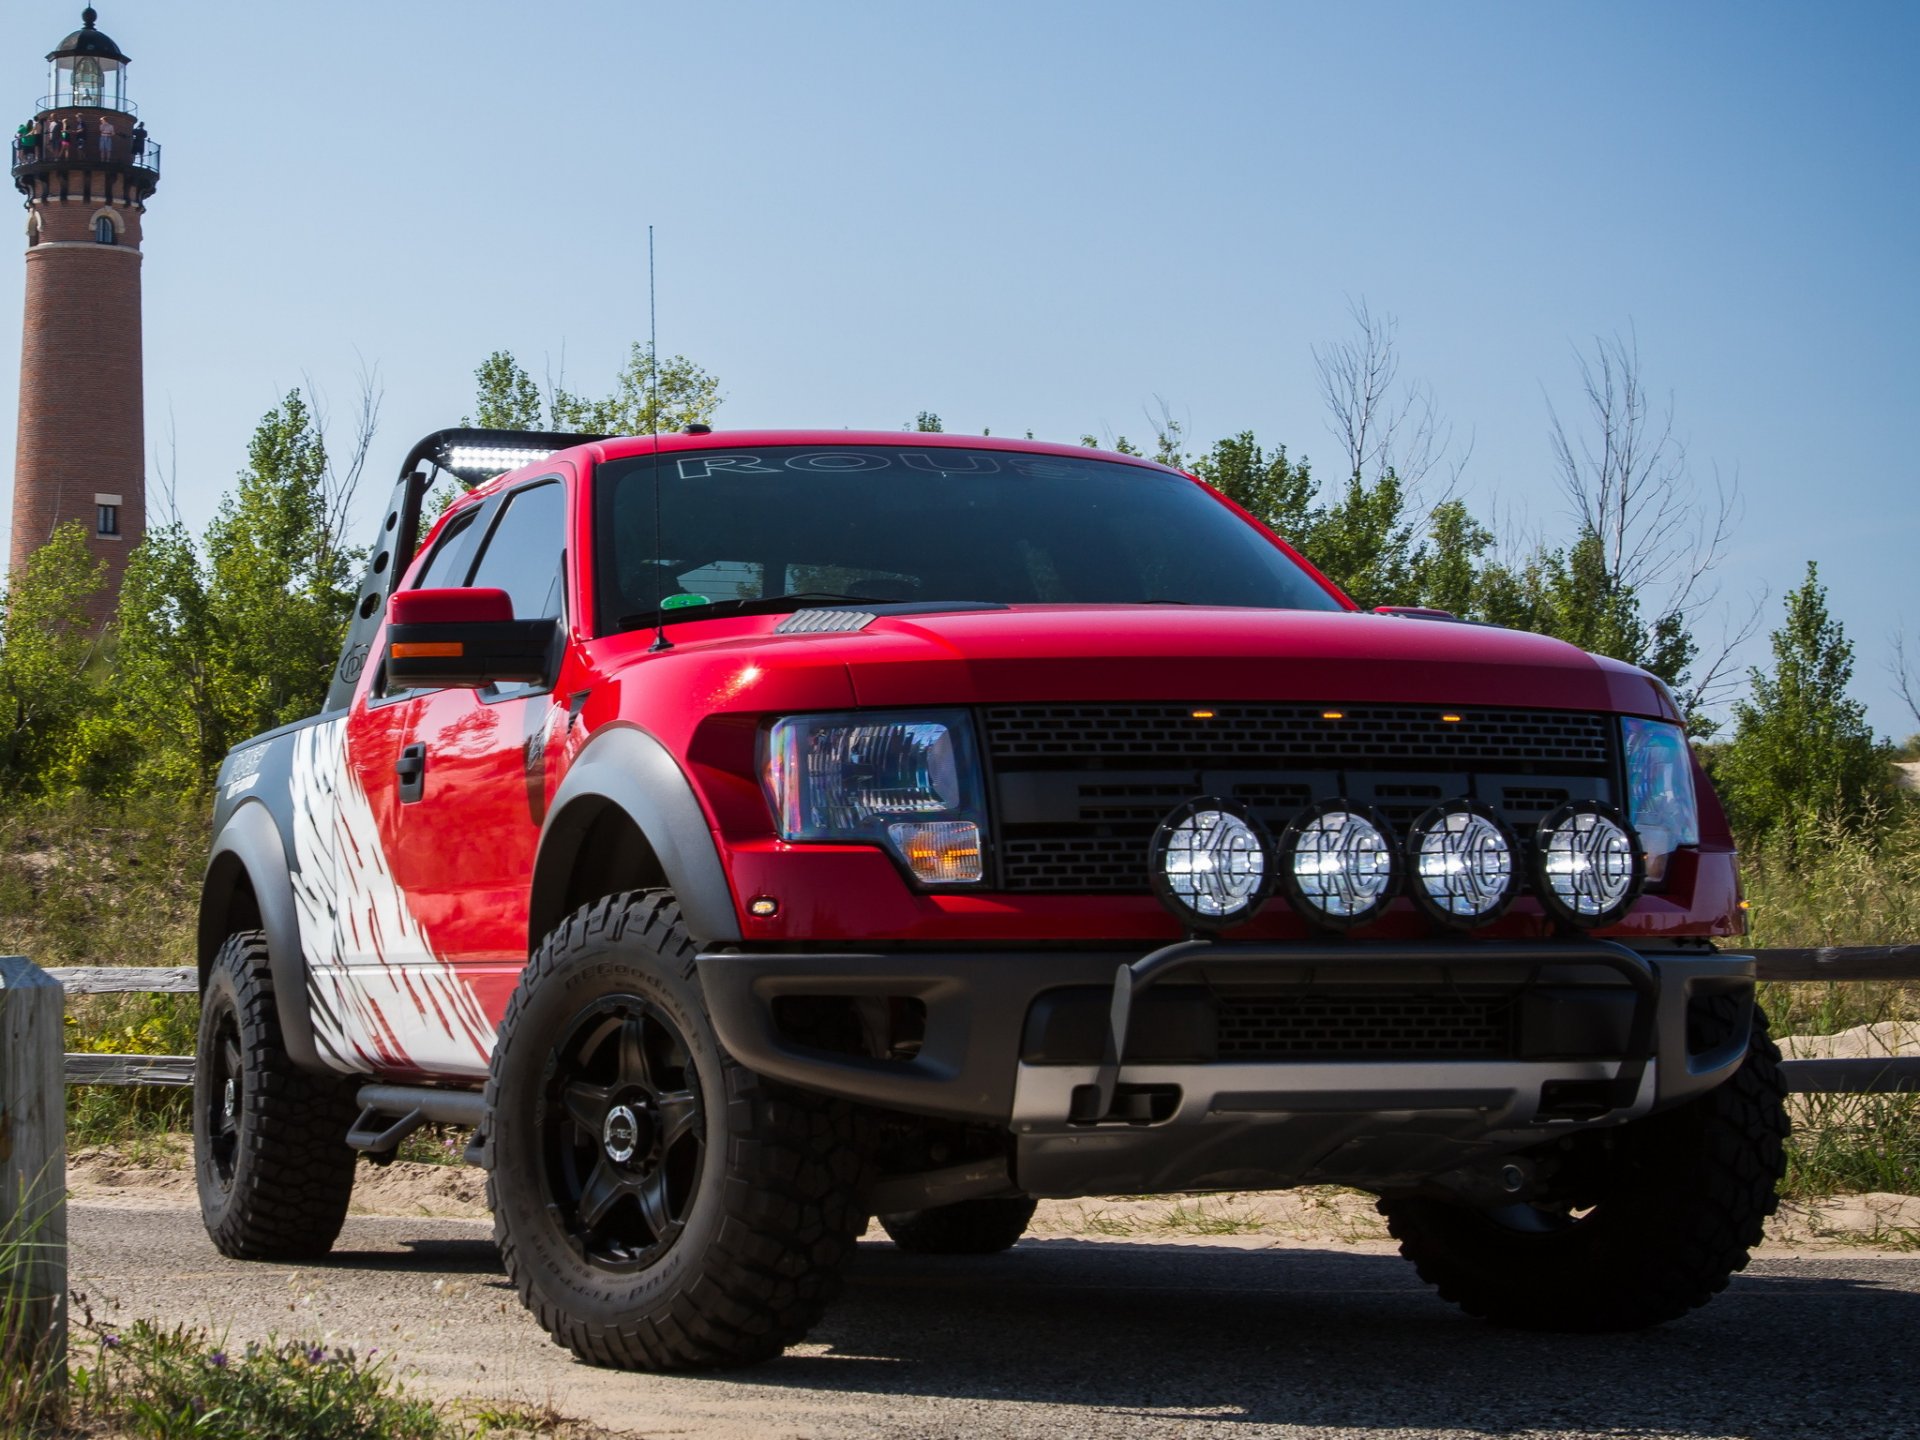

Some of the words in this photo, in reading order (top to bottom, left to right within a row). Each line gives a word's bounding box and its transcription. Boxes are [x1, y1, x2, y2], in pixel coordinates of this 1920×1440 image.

[676, 452, 1092, 482] ROUS
[1190, 820, 1256, 903] KC
[1318, 821, 1384, 903] KC
[1443, 822, 1505, 904] KC
[1571, 822, 1629, 903] KC
